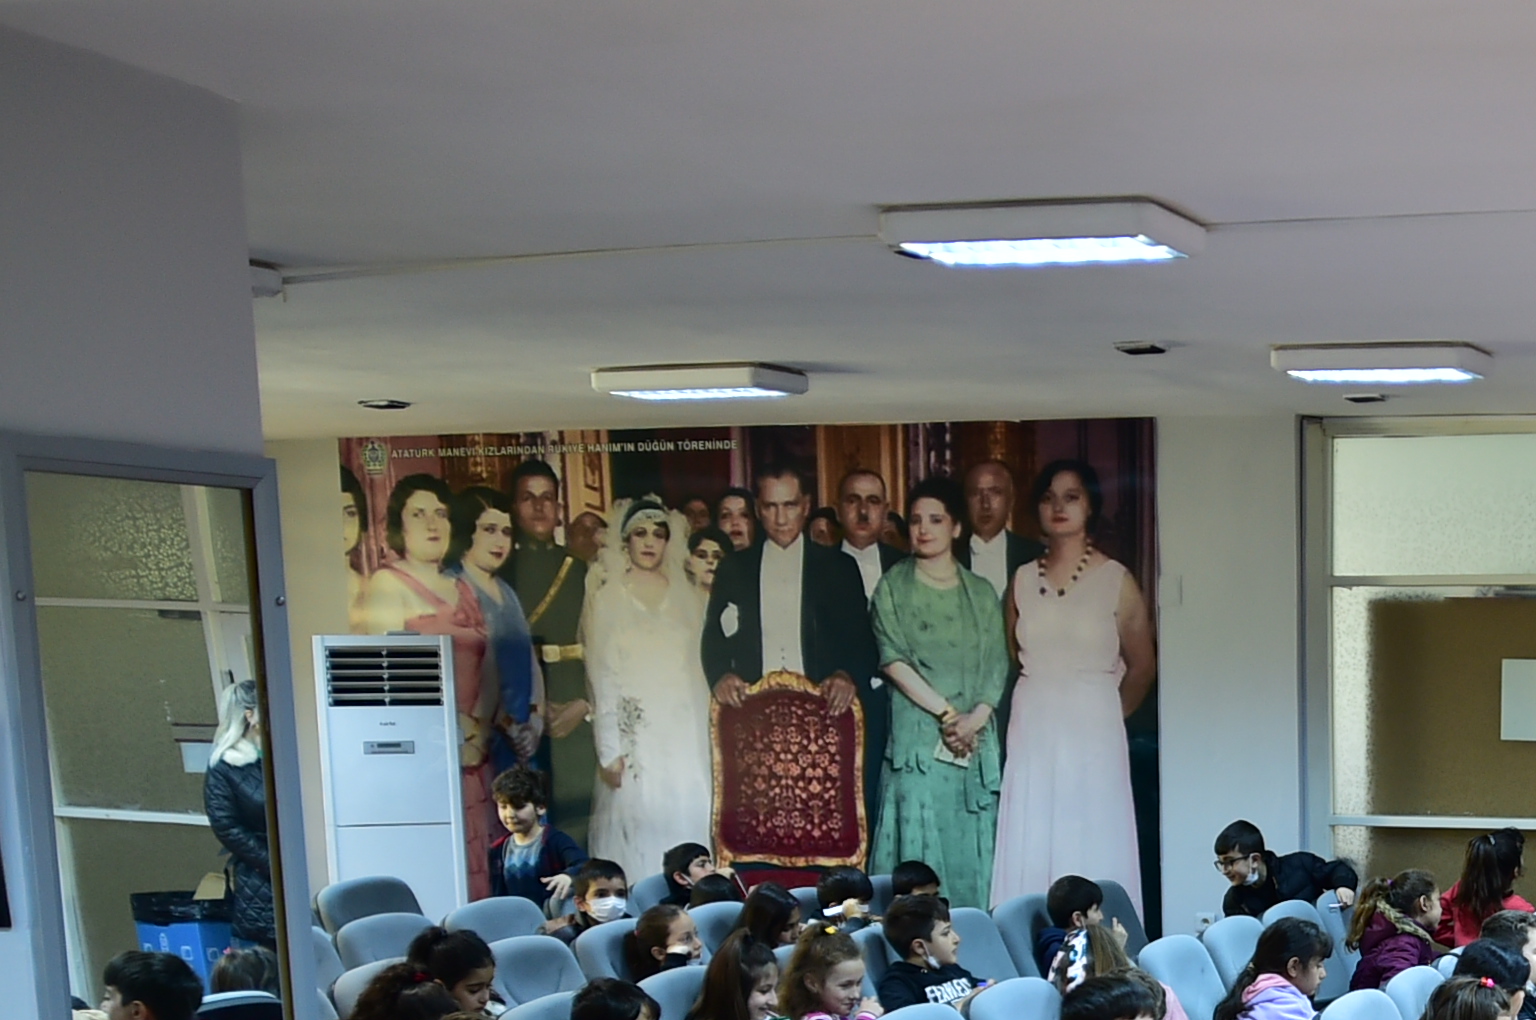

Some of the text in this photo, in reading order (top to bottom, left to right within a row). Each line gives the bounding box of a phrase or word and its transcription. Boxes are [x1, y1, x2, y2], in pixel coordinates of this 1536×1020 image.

[587, 442, 635, 453] HANIM'IN
[637, 439, 675, 452] DÜĞÜN
[677, 438, 738, 451] TÖRENİNDE
